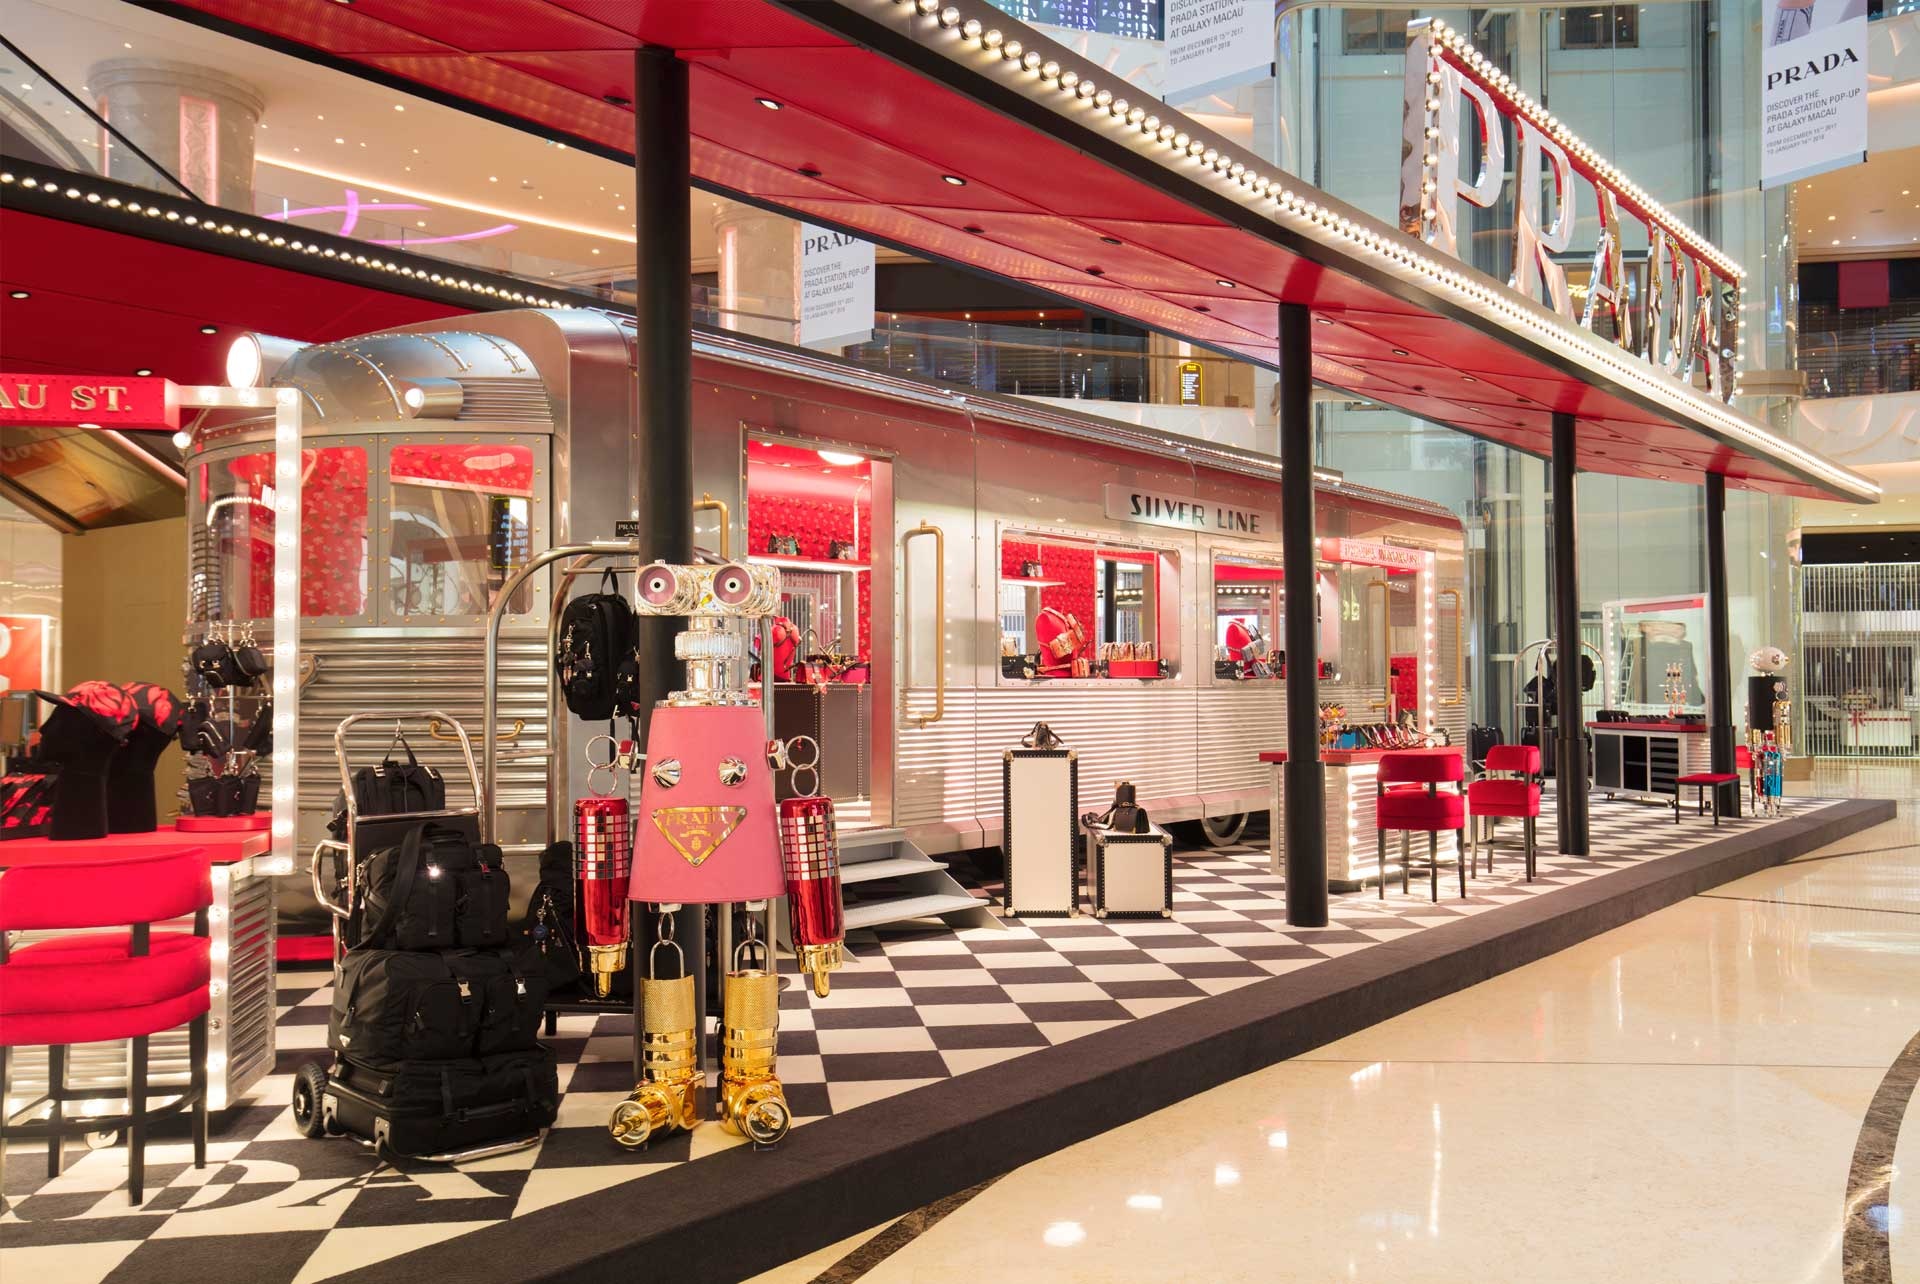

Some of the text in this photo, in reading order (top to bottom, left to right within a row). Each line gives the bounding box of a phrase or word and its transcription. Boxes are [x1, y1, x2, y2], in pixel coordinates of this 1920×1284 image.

[1170, 9, 1198, 26] PRADA
[1170, 7, 1244, 39] AT GALAXY MACAU
[1169, 45, 1187, 57] FROM
[1186, 34, 1218, 52] DECEMBER
[1170, 57, 1178, 65] TO
[1178, 48, 1205, 63] JANUARY
[1217, 40, 1231, 50] 2018
[1767, 47, 1859, 91] PRADA
[1767, 89, 1820, 113] DISCOVER THE
[1767, 87, 1861, 123] PRADA STATION POP-UP
[1767, 107, 1837, 135] AT GALAXY MACAU
[1434, 50, 1727, 404] PRADA
[804, 232, 859, 256] PRAD
[824, 271, 848, 285] STATION
[811, 285, 833, 299] GALAXY
[71, 386, 132, 411] ST.
[1131, 494, 1261, 534] SILVER LINE
